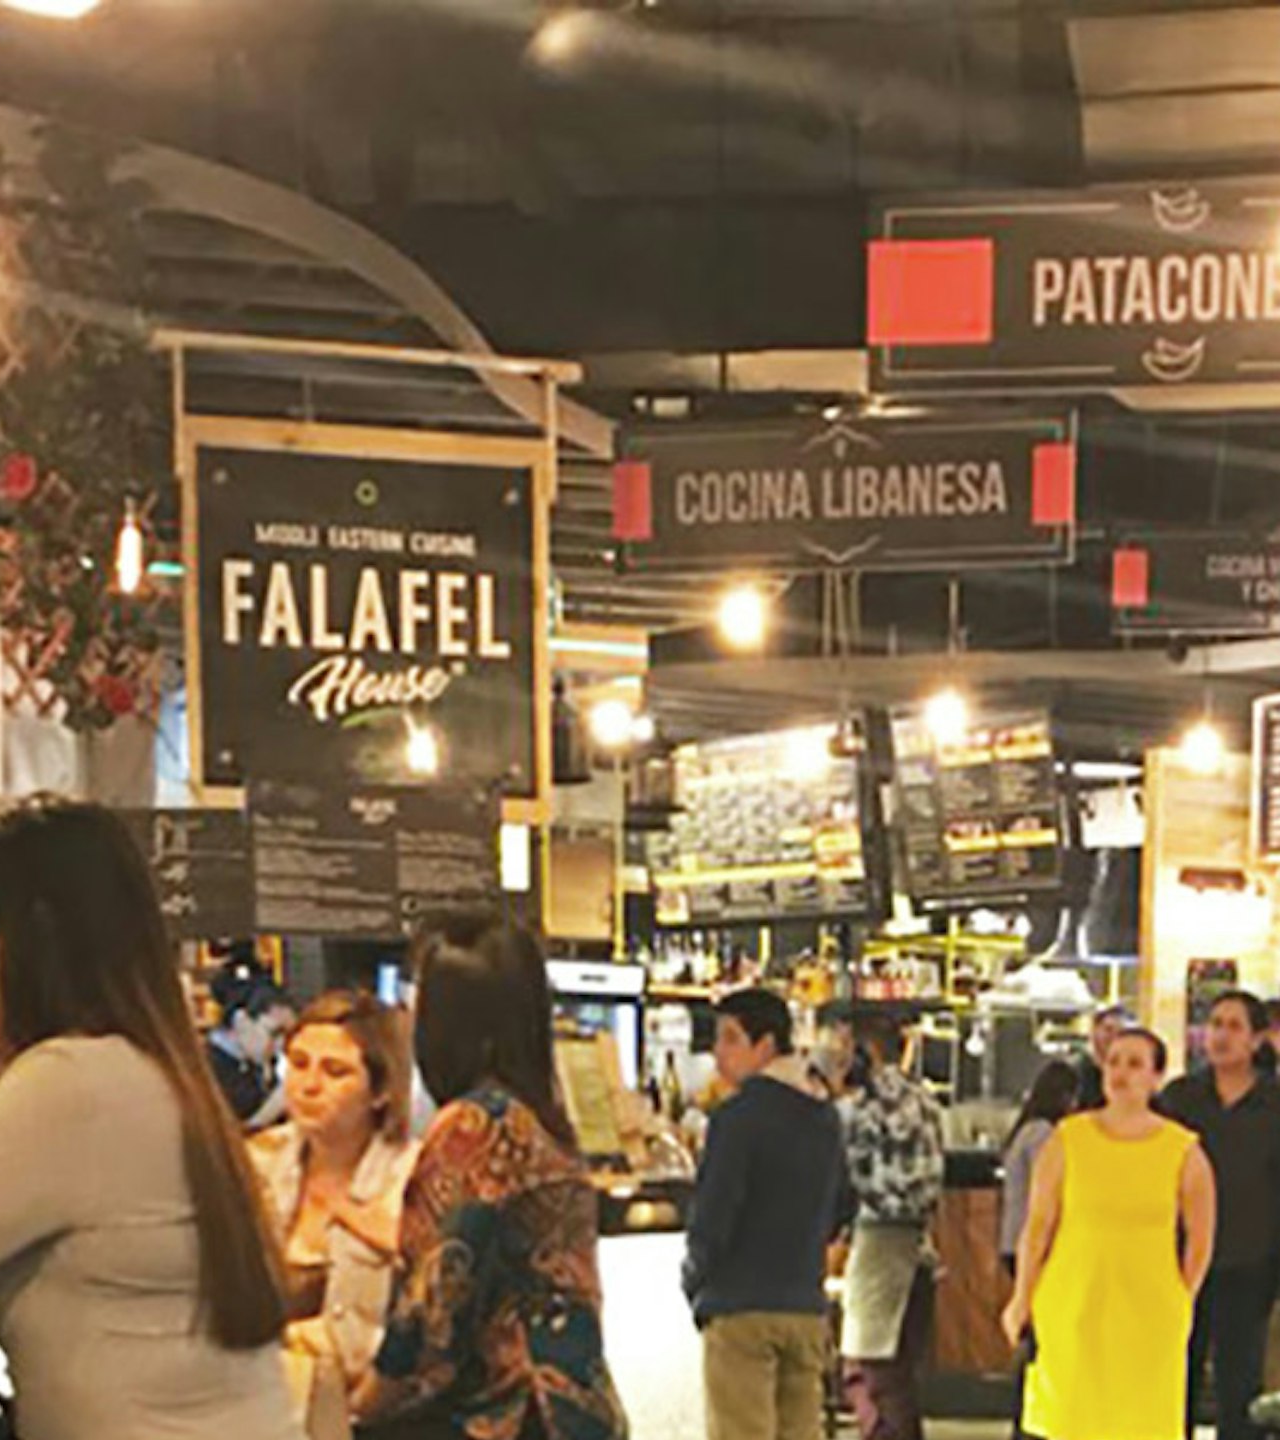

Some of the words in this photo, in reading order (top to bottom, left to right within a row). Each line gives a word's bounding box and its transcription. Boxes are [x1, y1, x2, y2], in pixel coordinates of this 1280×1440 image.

[675, 469, 813, 524] COCINA
[821, 460, 1008, 518] LIBANESA
[326, 525, 404, 551] EASTERN
[409, 530, 476, 558] CUISINE
[222, 558, 512, 659] FALAFEL
[287, 655, 450, 722] House
